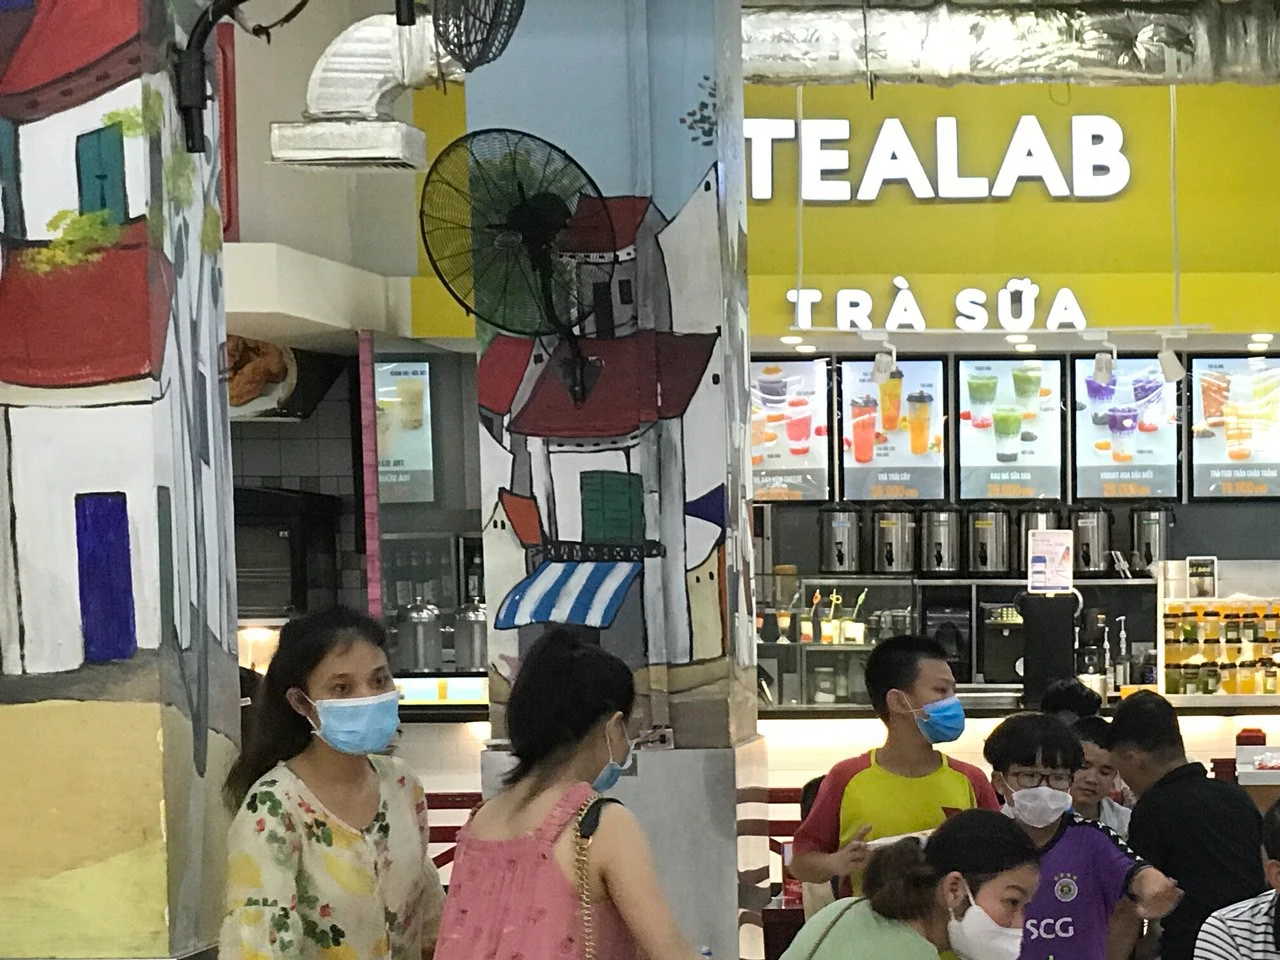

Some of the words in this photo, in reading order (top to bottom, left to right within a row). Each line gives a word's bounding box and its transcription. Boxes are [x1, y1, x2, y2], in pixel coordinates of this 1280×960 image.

[743, 114, 1132, 201] TEALAB
[786, 276, 926, 331] TRÀ
[954, 278, 1088, 331] SỮA
[1025, 917, 1075, 939] SCG
